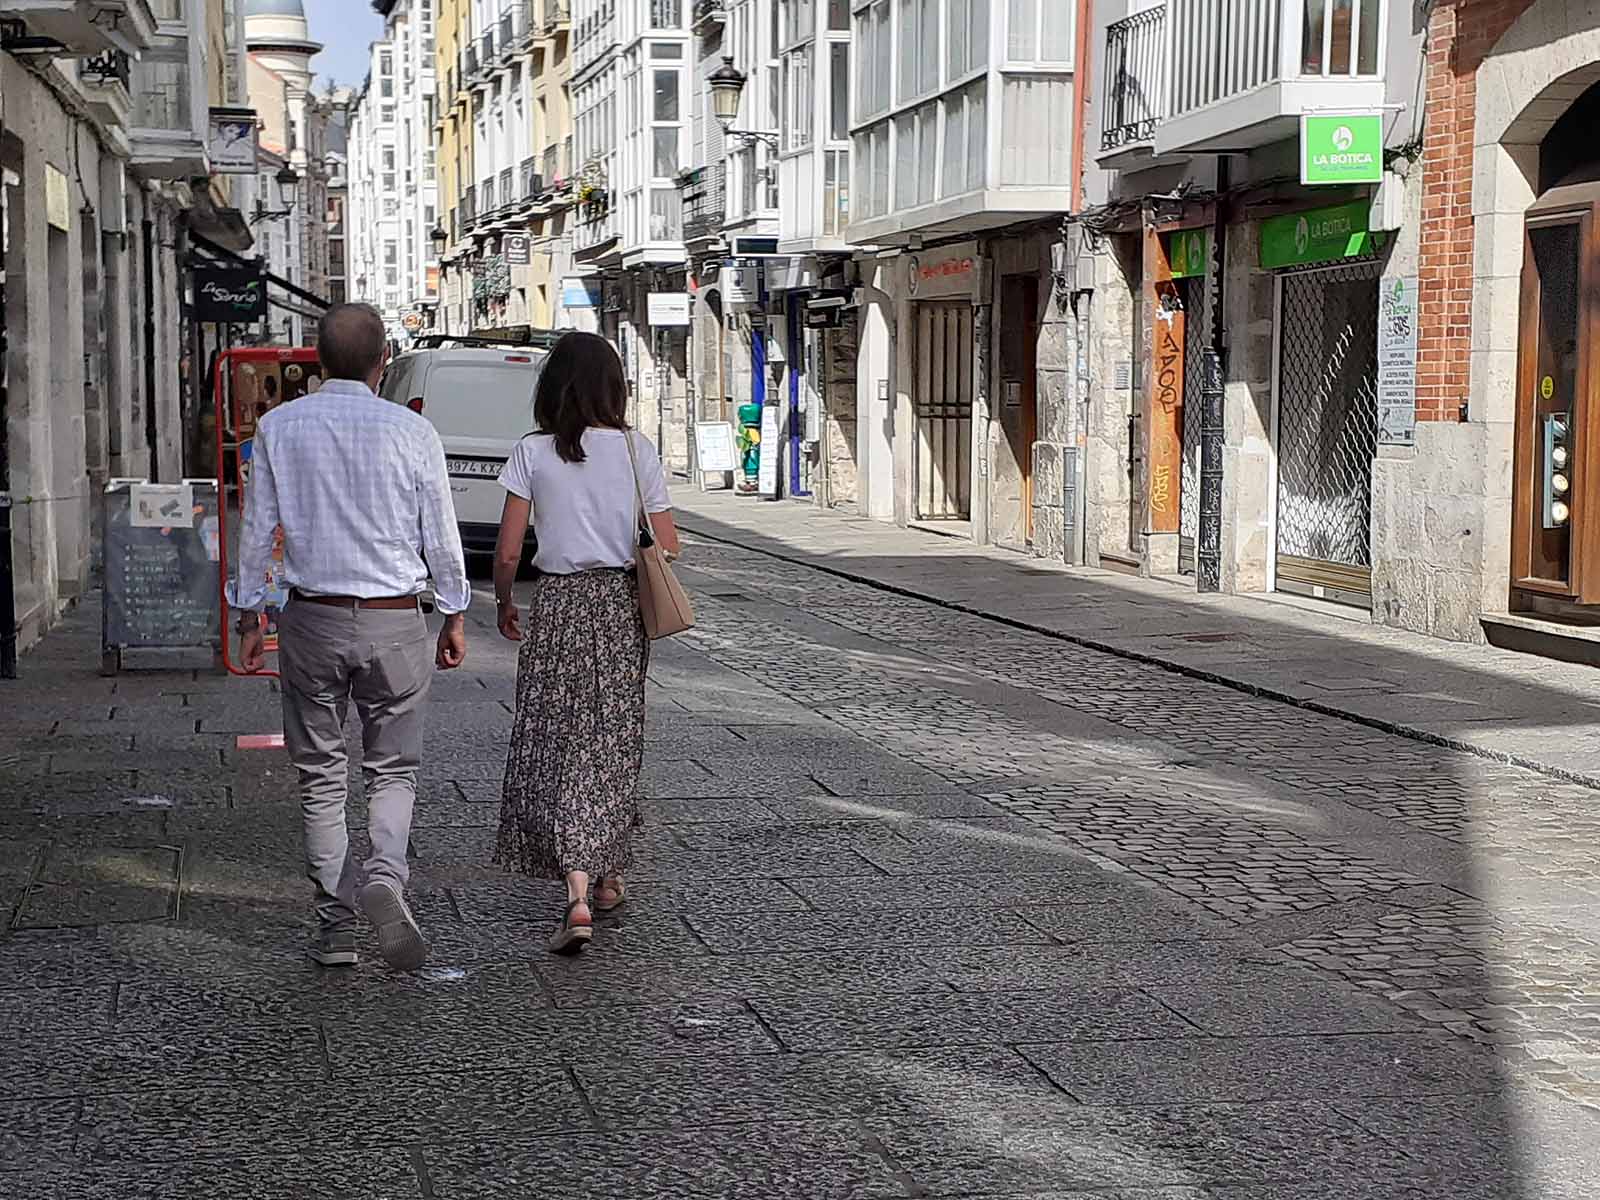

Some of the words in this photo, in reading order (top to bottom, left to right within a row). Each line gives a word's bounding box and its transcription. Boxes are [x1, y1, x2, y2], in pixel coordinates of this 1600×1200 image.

[1312, 154, 1328, 165] LA
[1330, 153, 1373, 163] BOTICA
[1312, 224, 1321, 238] LA
[1322, 217, 1352, 237] BOTICA
